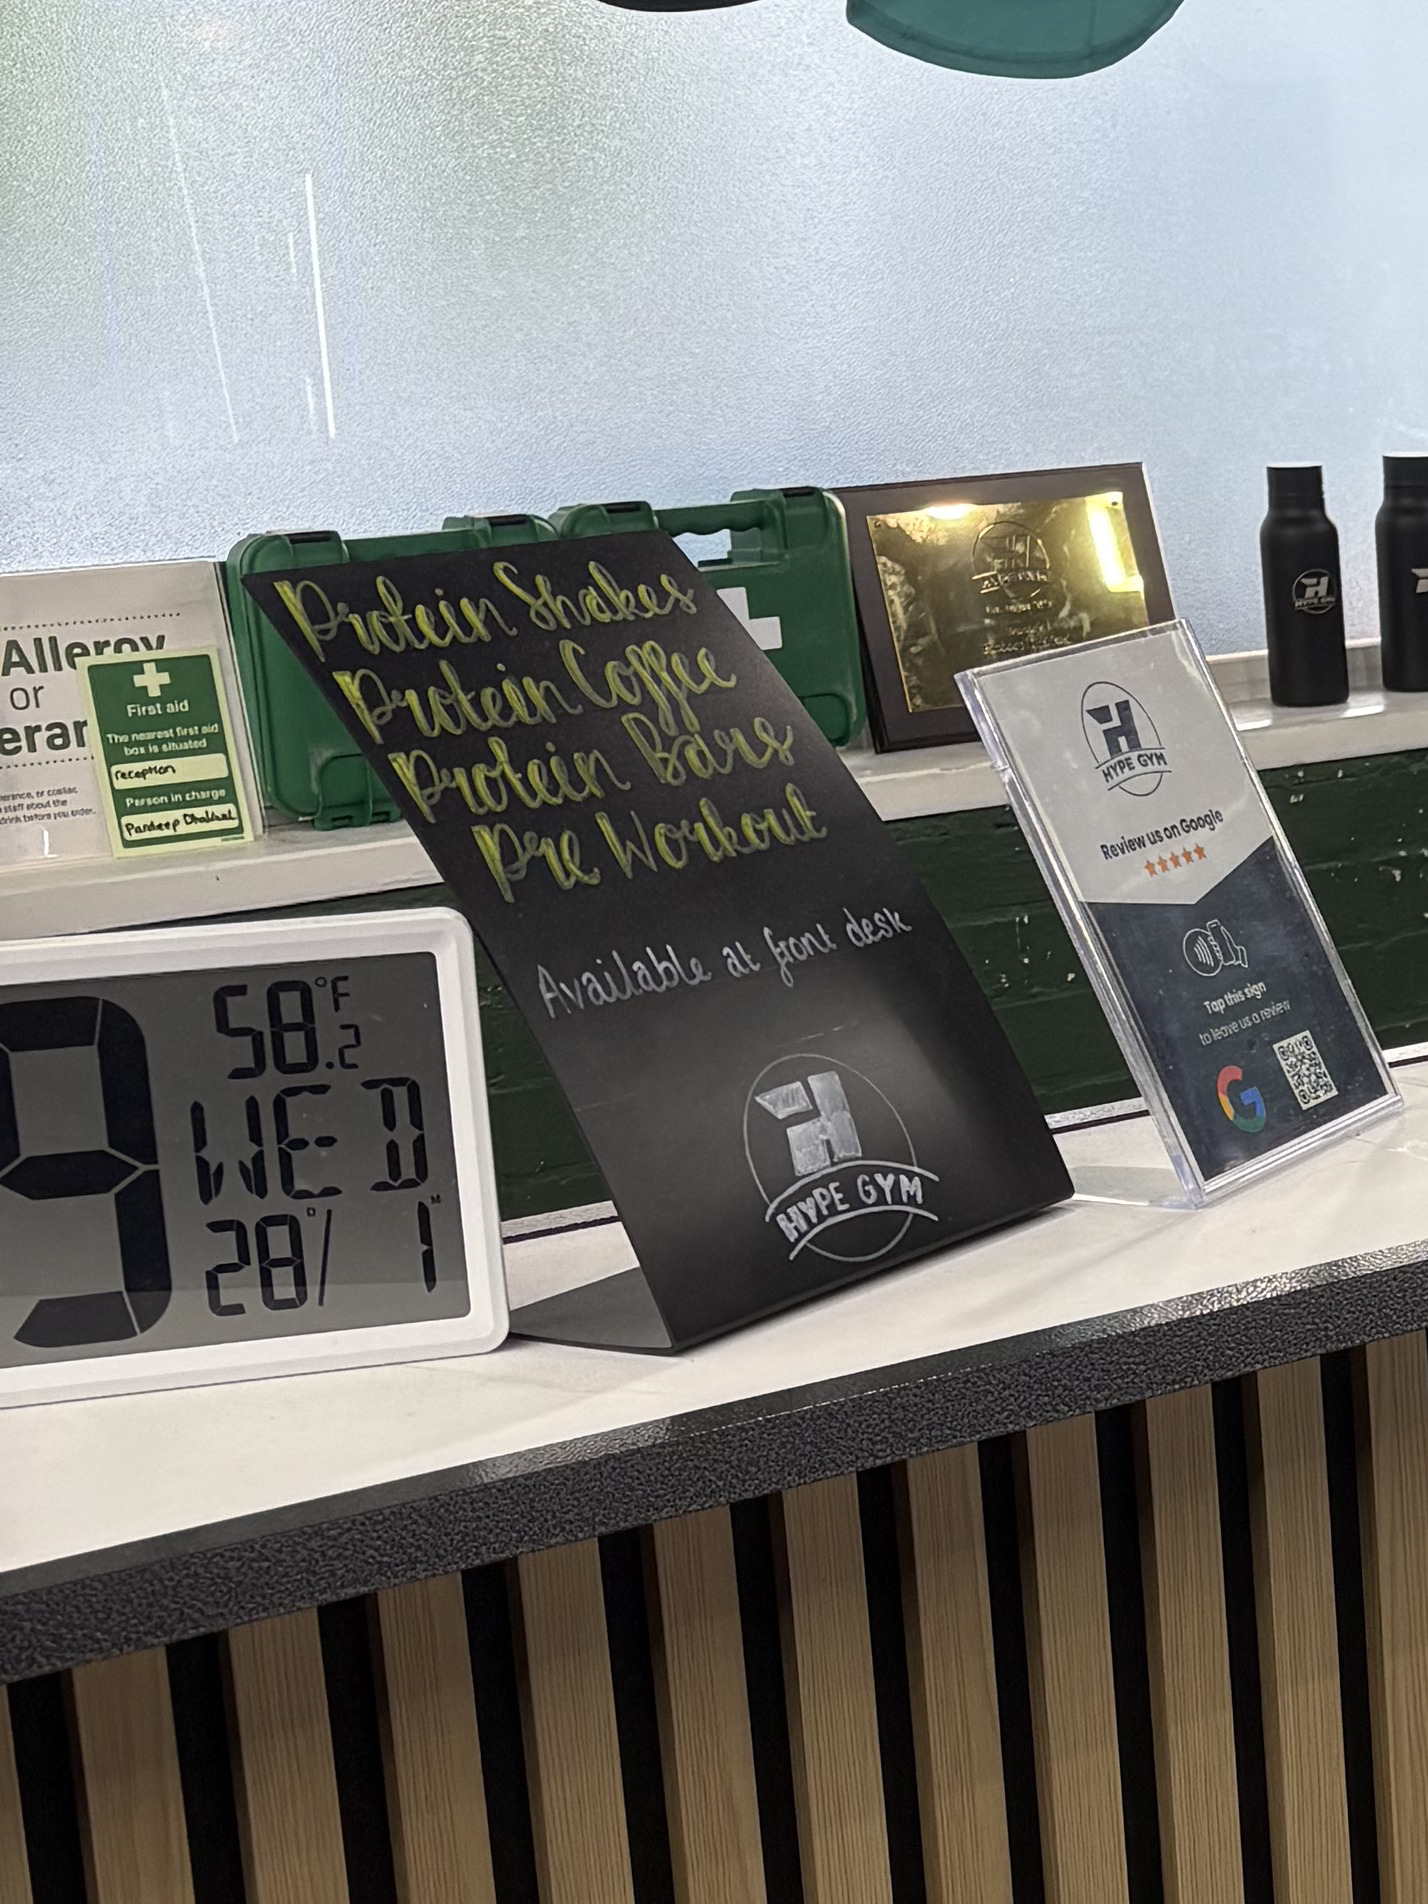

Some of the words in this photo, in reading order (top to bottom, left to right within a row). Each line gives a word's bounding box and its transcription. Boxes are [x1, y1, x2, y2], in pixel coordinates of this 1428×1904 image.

[274, 576, 518, 662] Protein
[493, 560, 698, 632] Shakes
[10, 684, 45, 710] or
[332, 659, 583, 744] Protein
[558, 638, 738, 736] Coffee
[126, 703, 162, 718] First
[166, 700, 189, 713] aid
[106, 733, 129, 744] The
[131, 728, 174, 742] nearest
[175, 726, 199, 737] first
[201, 723, 219, 734] aid
[124, 745, 146, 756] box
[149, 743, 160, 753] is
[161, 738, 207, 752] situated
[115, 765, 176, 781] reception
[388, 736, 631, 824] Protein
[621, 712, 795, 787] Bars
[1102, 757, 1136, 783] HYPE
[1137, 752, 1168, 767] GYM
[126, 796, 168, 808] Person
[170, 793, 182, 802] in
[185, 789, 226, 801] charge
[471, 824, 600, 903] Pre
[595, 783, 828, 879] Workout
[1100, 833, 1147, 860] Review
[1146, 830, 1163, 846] us
[1164, 823, 1181, 839] on
[1180, 809, 1224, 832] Google
[535, 944, 712, 1019] Available
[722, 941, 761, 979] at
[762, 923, 838, 987] front
[843, 907, 913, 948] desk
[1203, 998, 1225, 1014] Tap
[1224, 988, 1245, 1006] this
[1244, 981, 1267, 999] sign
[1199, 1033, 1212, 1046] to
[1210, 1020, 1240, 1041] leave
[1240, 1016, 1252, 1030] us
[190, 1077, 429, 1205] WED
[776, 1182, 850, 1243] HYPE
[857, 1173, 923, 1205] GYM
